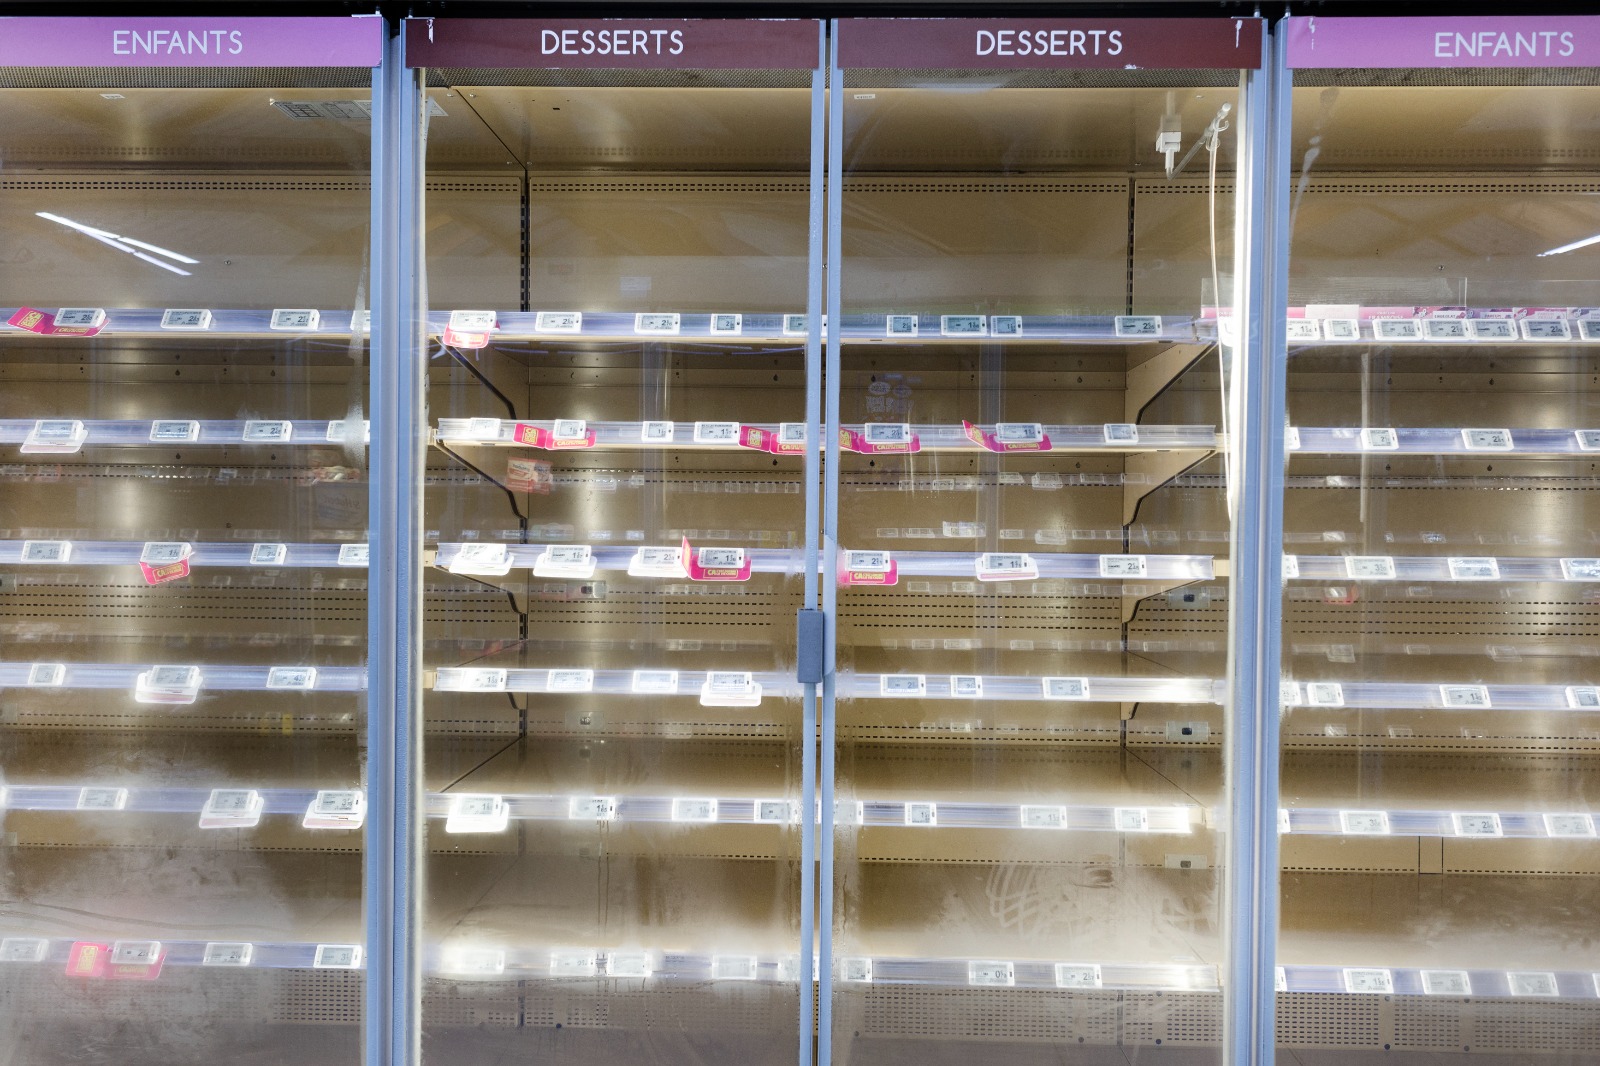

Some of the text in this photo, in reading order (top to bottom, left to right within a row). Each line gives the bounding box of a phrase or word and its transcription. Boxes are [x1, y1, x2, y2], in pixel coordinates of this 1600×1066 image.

[113, 30, 243, 55] ENFANTS
[541, 29, 684, 55] DESSERTS
[976, 30, 1123, 56] DESSERTS
[1434, 31, 1575, 57] ENFANTS
